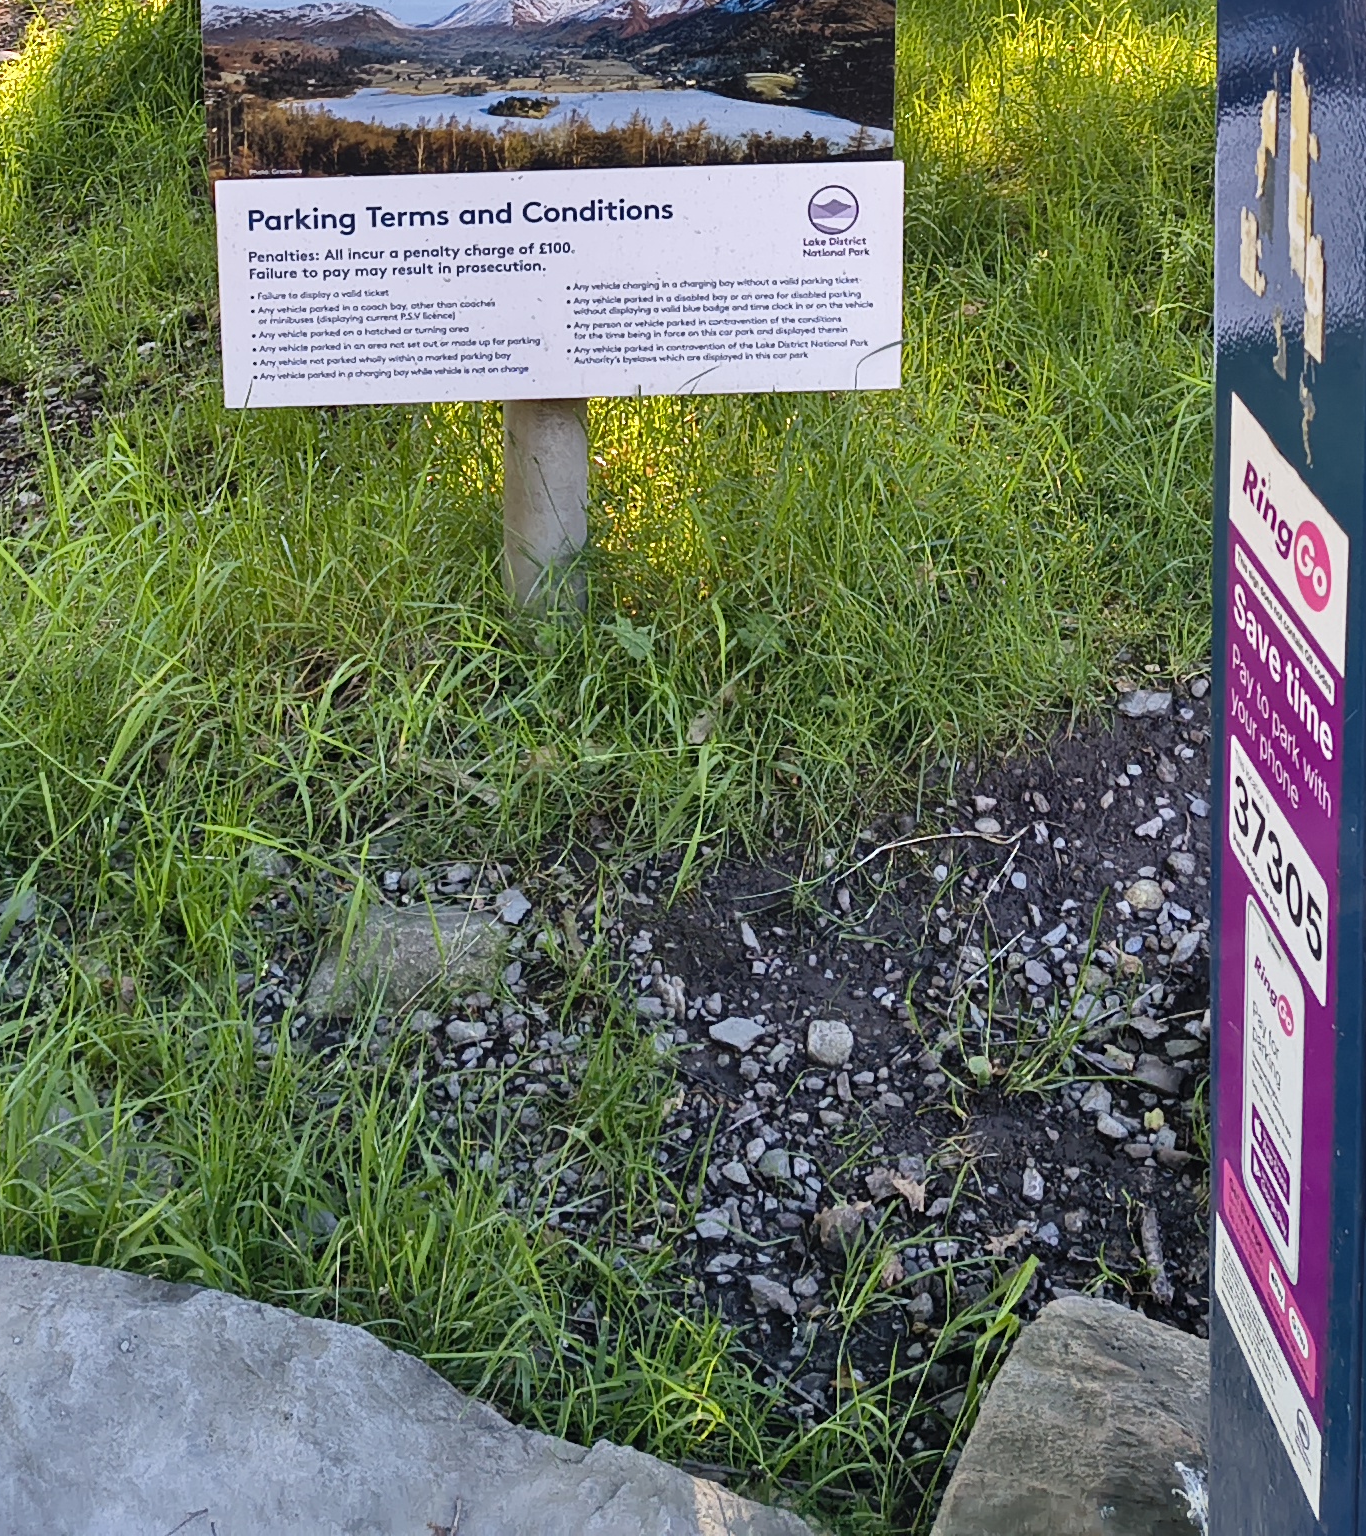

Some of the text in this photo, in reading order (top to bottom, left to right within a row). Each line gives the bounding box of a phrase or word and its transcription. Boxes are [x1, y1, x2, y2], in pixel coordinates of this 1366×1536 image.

[248, 198, 673, 236] Parking Terms and Conditions
[1242, 460, 1327, 597] RingGo
[1231, 687, 1298, 809] your phone
[1232, 643, 1332, 818] Pay to park with
[1234, 584, 1333, 760] Save time
[1234, 775, 1323, 962] 37305
